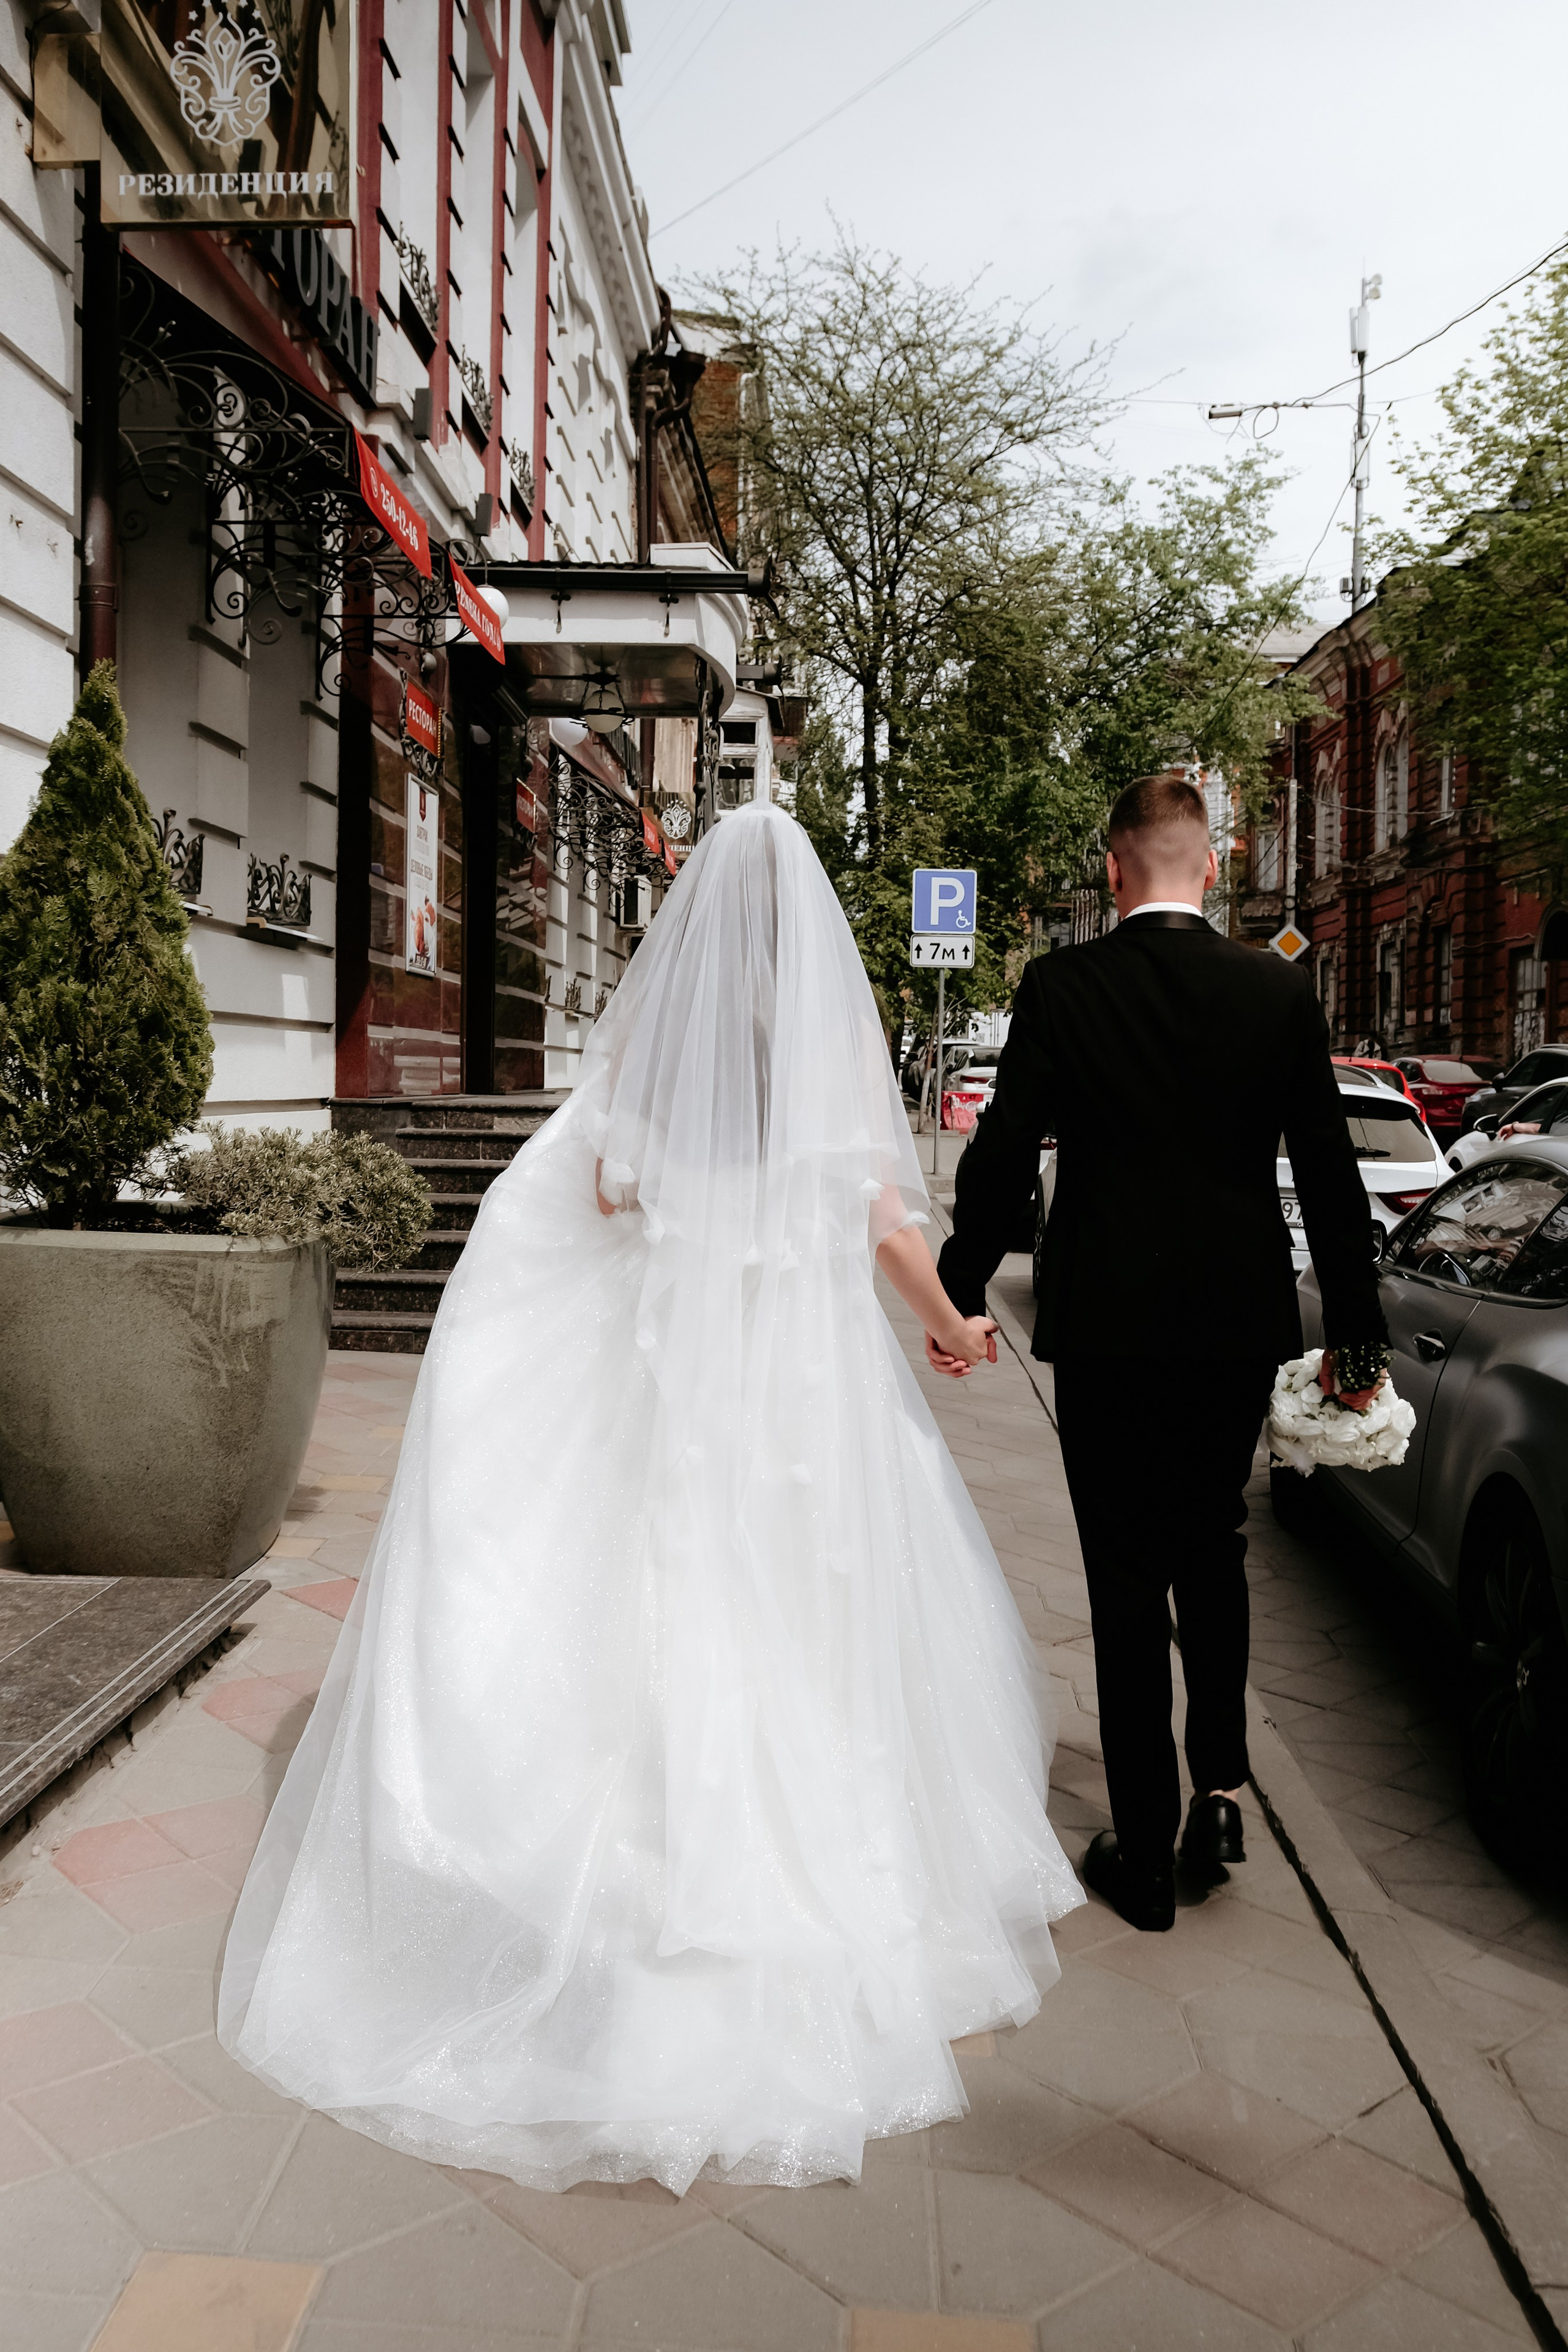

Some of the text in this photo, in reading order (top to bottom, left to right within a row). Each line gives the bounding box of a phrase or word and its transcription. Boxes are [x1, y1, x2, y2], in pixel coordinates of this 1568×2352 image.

[118, 172, 334, 200] РЕЗИДЕНЦИЯ
[380, 483, 419, 551] 250-12-46
[409, 698, 437, 737] РЕСТОРАН
[930, 877, 965, 925] P
